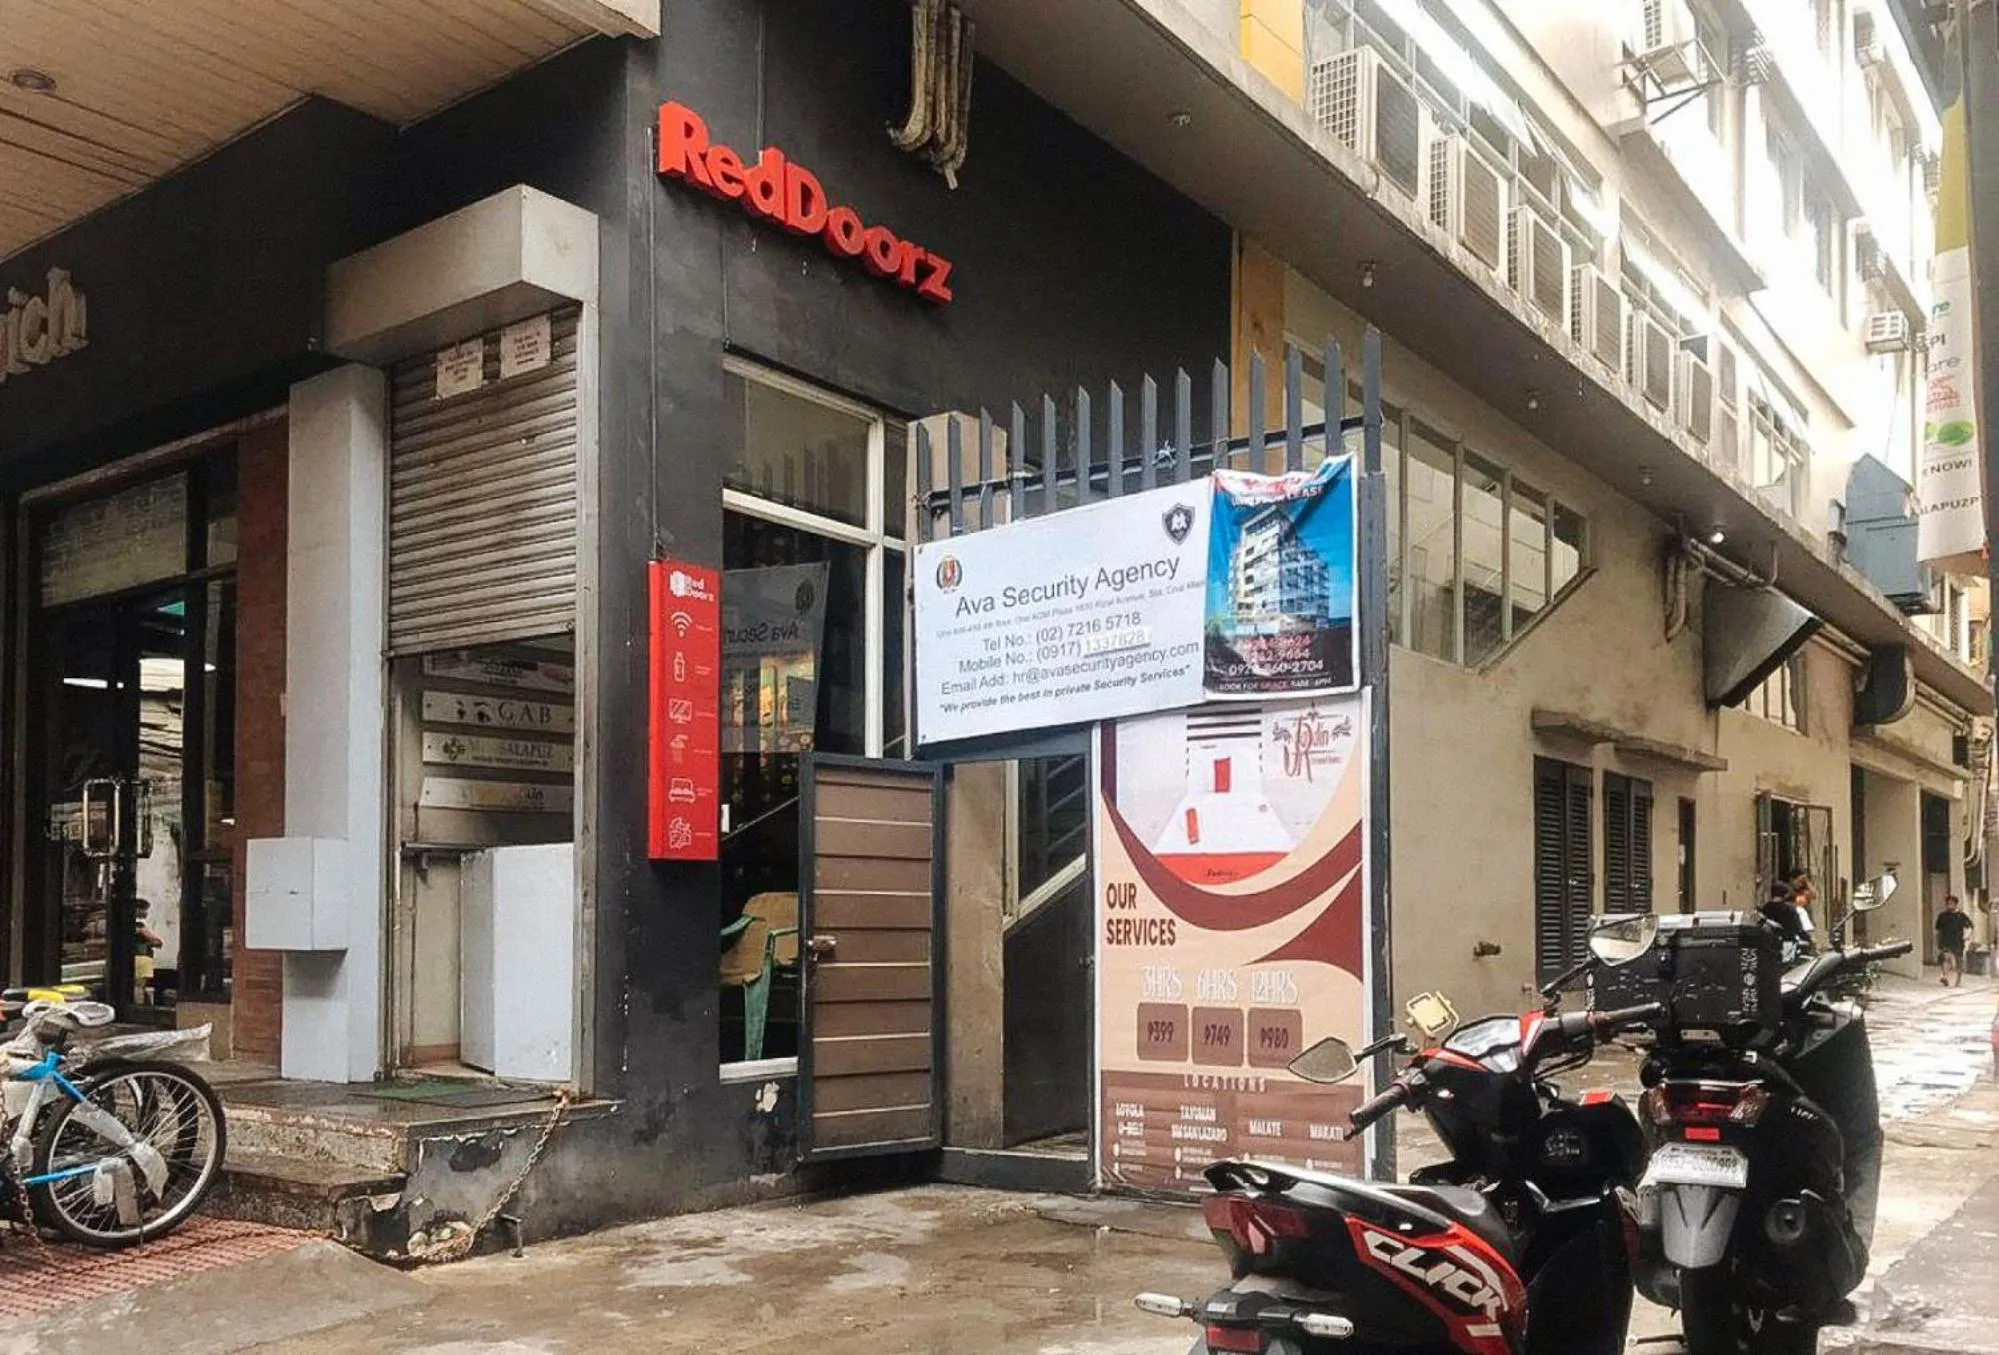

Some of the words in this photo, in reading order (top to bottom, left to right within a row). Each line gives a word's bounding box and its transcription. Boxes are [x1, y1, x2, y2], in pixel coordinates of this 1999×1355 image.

[657, 101, 953, 302] RedDoorz
[955, 595, 996, 617] Ava
[1002, 573, 1089, 608] Security
[1094, 555, 1181, 592] Agency
[982, 636, 1001, 652] Tel
[1036, 625, 1063, 646] (02)
[1067, 619, 1102, 638] 7216
[1104, 610, 1143, 631] 5718
[941, 677, 978, 695] Email
[1012, 641, 1200, 685] hr@avasecurityagency.com
[958, 655, 1002, 675] Mobile
[1036, 640, 1082, 665] (0917)
[498, 702, 552, 725] GAB
[960, 698, 998, 716] provide
[999, 694, 1017, 705] the
[1018, 690, 1041, 703] best
[1054, 682, 1091, 698] private
[1093, 674, 1138, 692] Security
[1105, 882, 1138, 910] OUR
[1106, 917, 1177, 947] SERVICES
[1141, 964, 1183, 1000] 3HRS
[1196, 966, 1238, 1001] 6HRS
[1251, 969, 1298, 1005] 12HRS
[1182, 1074, 1266, 1093] LOCATIONS
[1248, 1118, 1282, 1137] MALATE
[1362, 1229, 1502, 1323] CLICK
